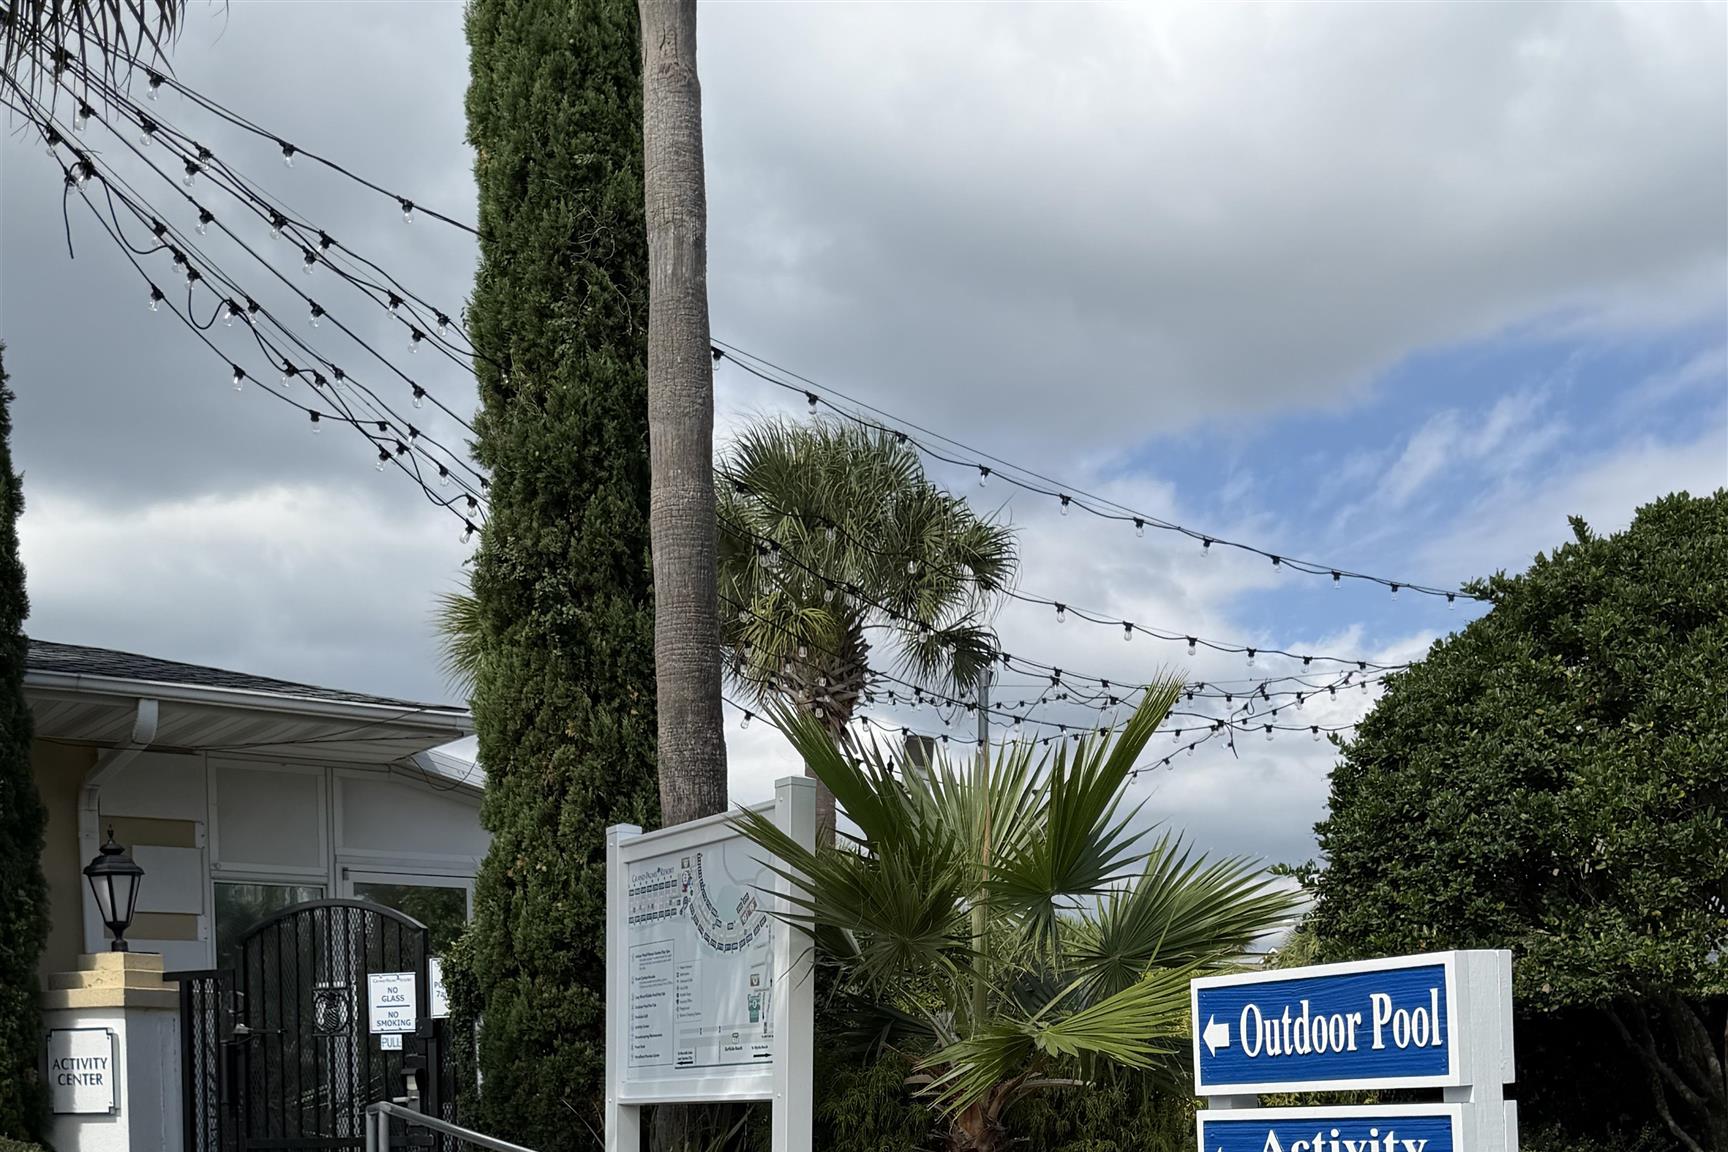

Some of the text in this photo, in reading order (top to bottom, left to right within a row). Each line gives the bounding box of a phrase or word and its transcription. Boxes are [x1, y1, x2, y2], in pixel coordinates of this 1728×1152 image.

[381, 995, 405, 1003] GLASS
[376, 1019, 411, 1027] SMOKING
[1239, 988, 1443, 1058] Outdoor Pool
[381, 1037, 402, 1049] PULL
[52, 1057, 108, 1070] ACTIVITY
[57, 1073, 103, 1086] CENTER
